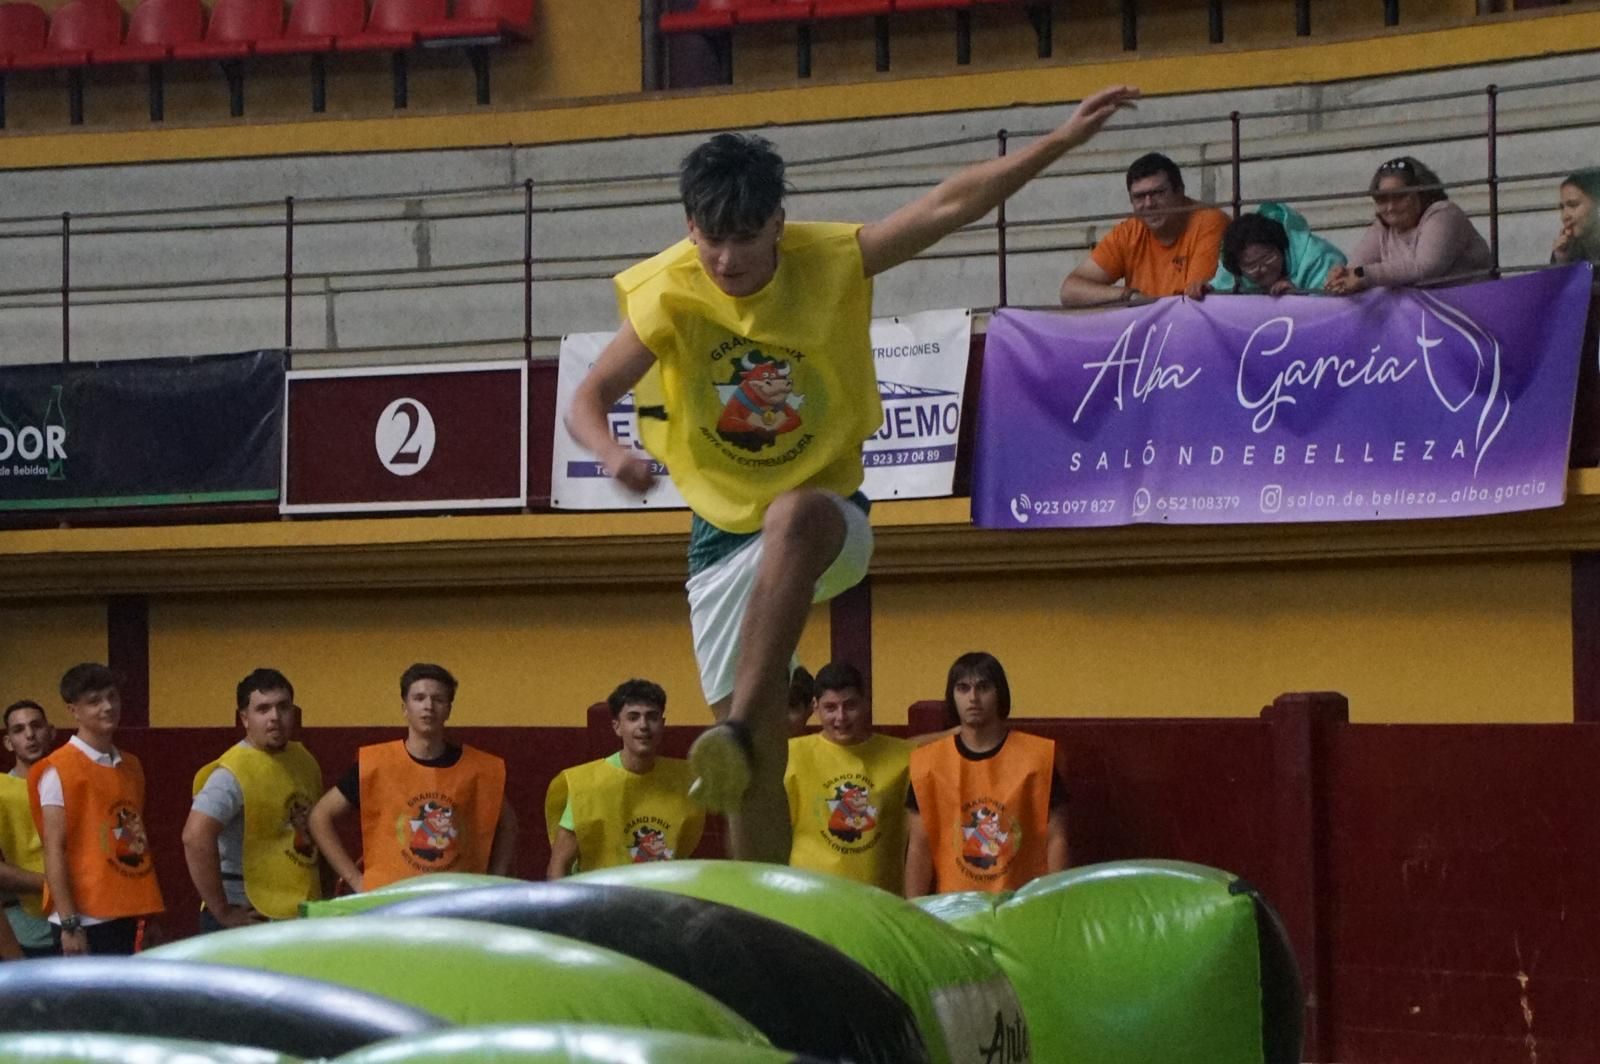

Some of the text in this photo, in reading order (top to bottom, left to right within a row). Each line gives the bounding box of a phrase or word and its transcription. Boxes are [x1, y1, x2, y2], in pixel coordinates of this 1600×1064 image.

[1073, 316, 1418, 433] Alba García
[389, 402, 422, 465] 2
[868, 402, 960, 441] JEMO
[737, 433, 815, 467] EXTREMADURA
[872, 453, 893, 465] 923
[895, 452, 909, 464] 37
[911, 451, 924, 463] 04
[927, 449, 940, 461] 89
[14, 464, 49, 476] Bebidas
[650, 463, 665, 473] 37
[1034, 500, 1116, 515] 923 097 827
